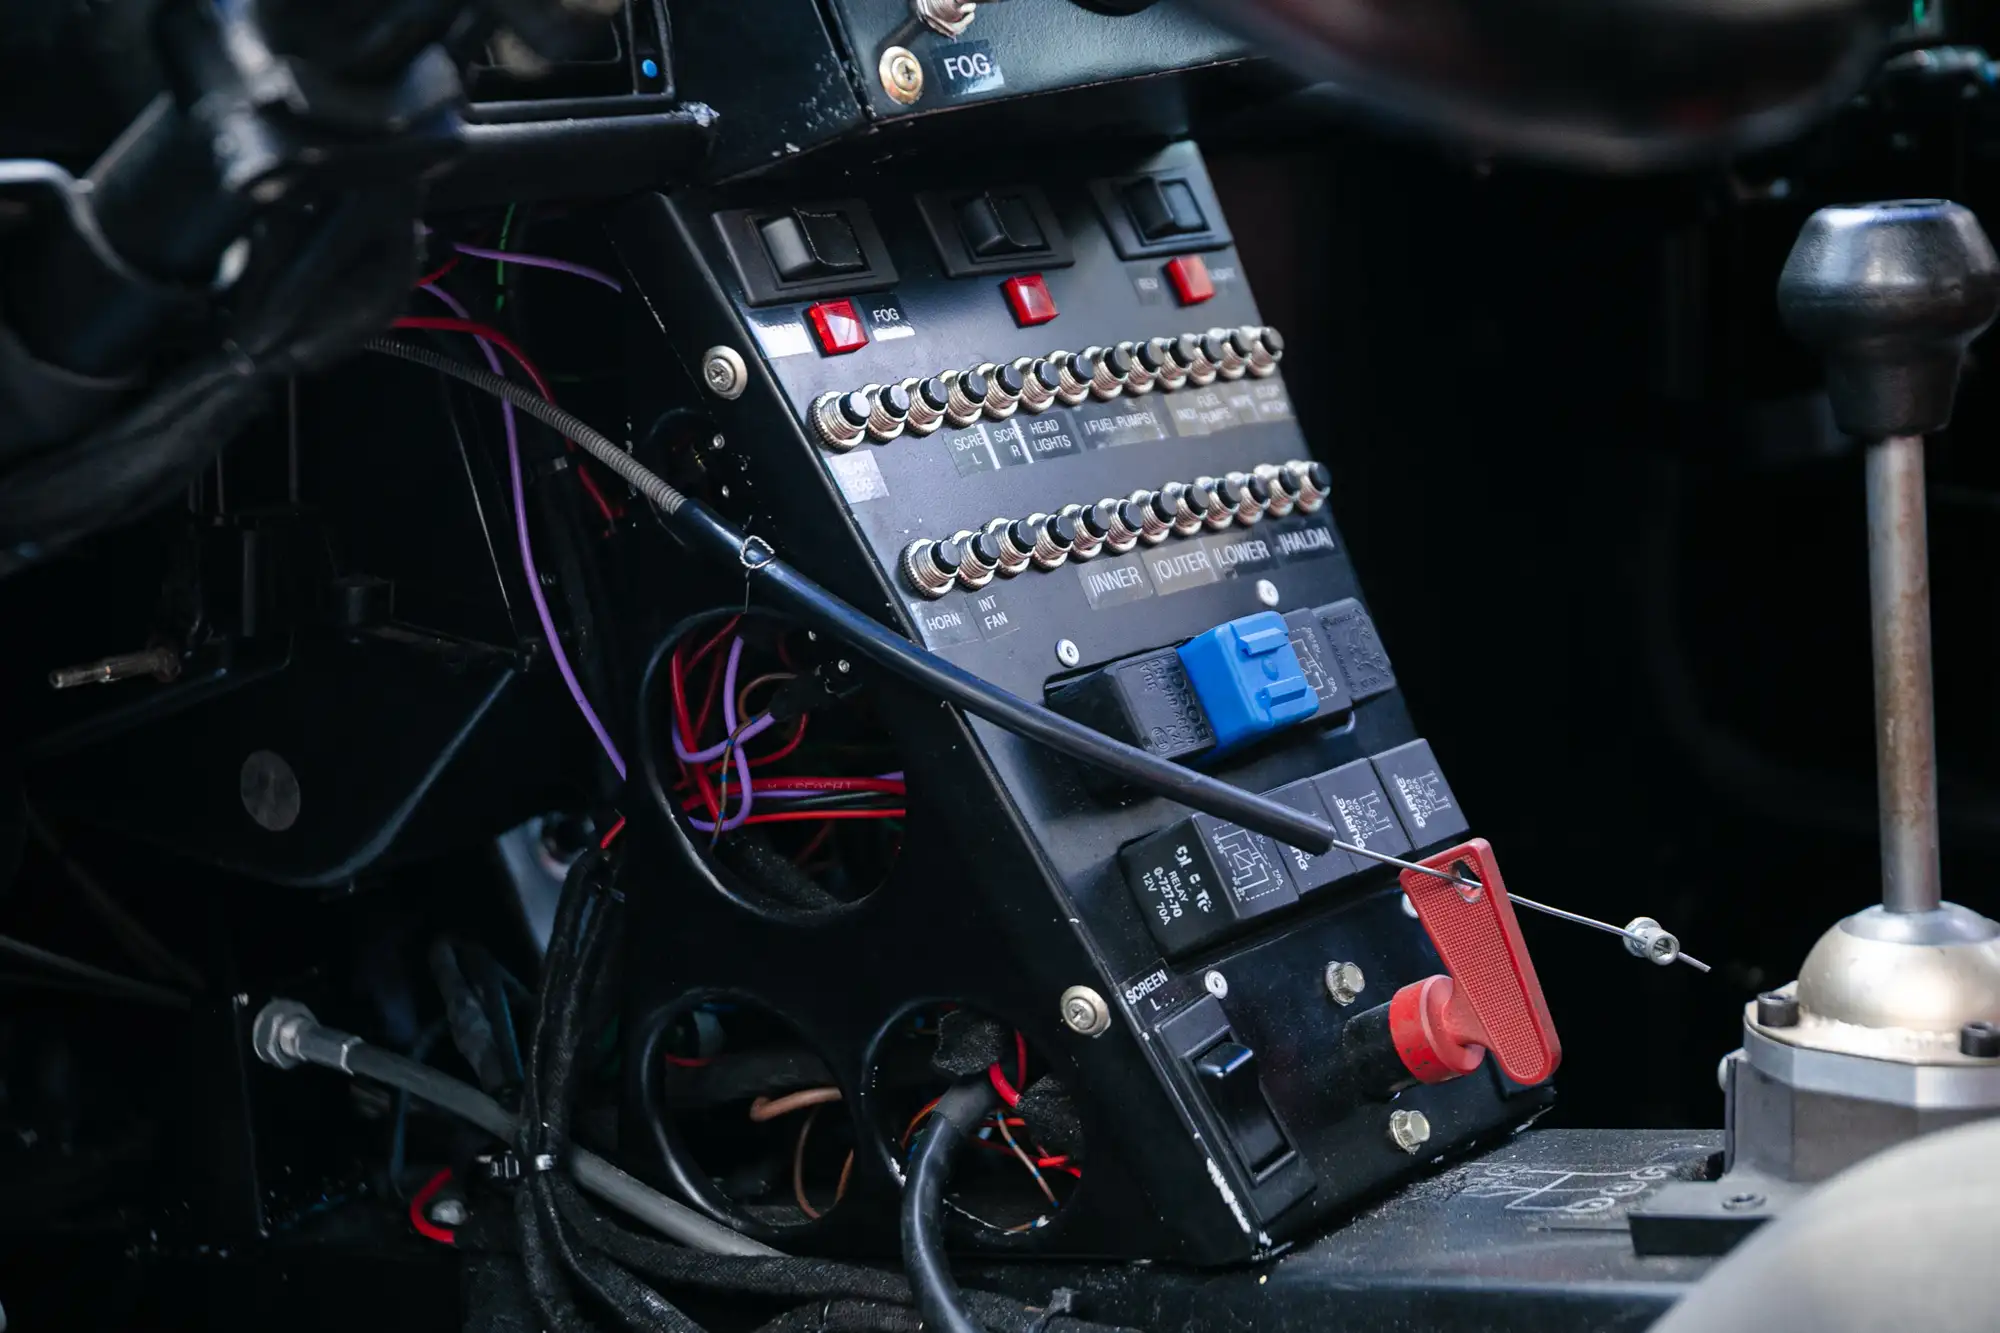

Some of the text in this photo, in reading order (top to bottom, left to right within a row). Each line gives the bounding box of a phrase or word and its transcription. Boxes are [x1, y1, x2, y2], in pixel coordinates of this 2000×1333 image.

[944, 52, 991, 80] FOG
[872, 307, 900, 322] FOG
[1029, 419, 1059, 435] HEAD
[1089, 411, 1151, 433] FUEL PUMPS
[993, 426, 1022, 443] SCR
[1032, 435, 1071, 452] LIGHTS
[972, 452, 982, 464] L
[1010, 445, 1021, 457] R
[978, 595, 996, 612] INT
[926, 612, 962, 631] HORN
[984, 611, 1008, 630] FAN
[1395, 777, 1426, 828] DURITE
[1335, 797, 1365, 850] DURITE
[1153, 866, 1182, 917] 0-727-70
[1168, 870, 1188, 901] RELAY
[1142, 872, 1171, 925] 12V 70A
[1125, 969, 1168, 1005] SCREEN
[1150, 998, 1161, 1011] L
